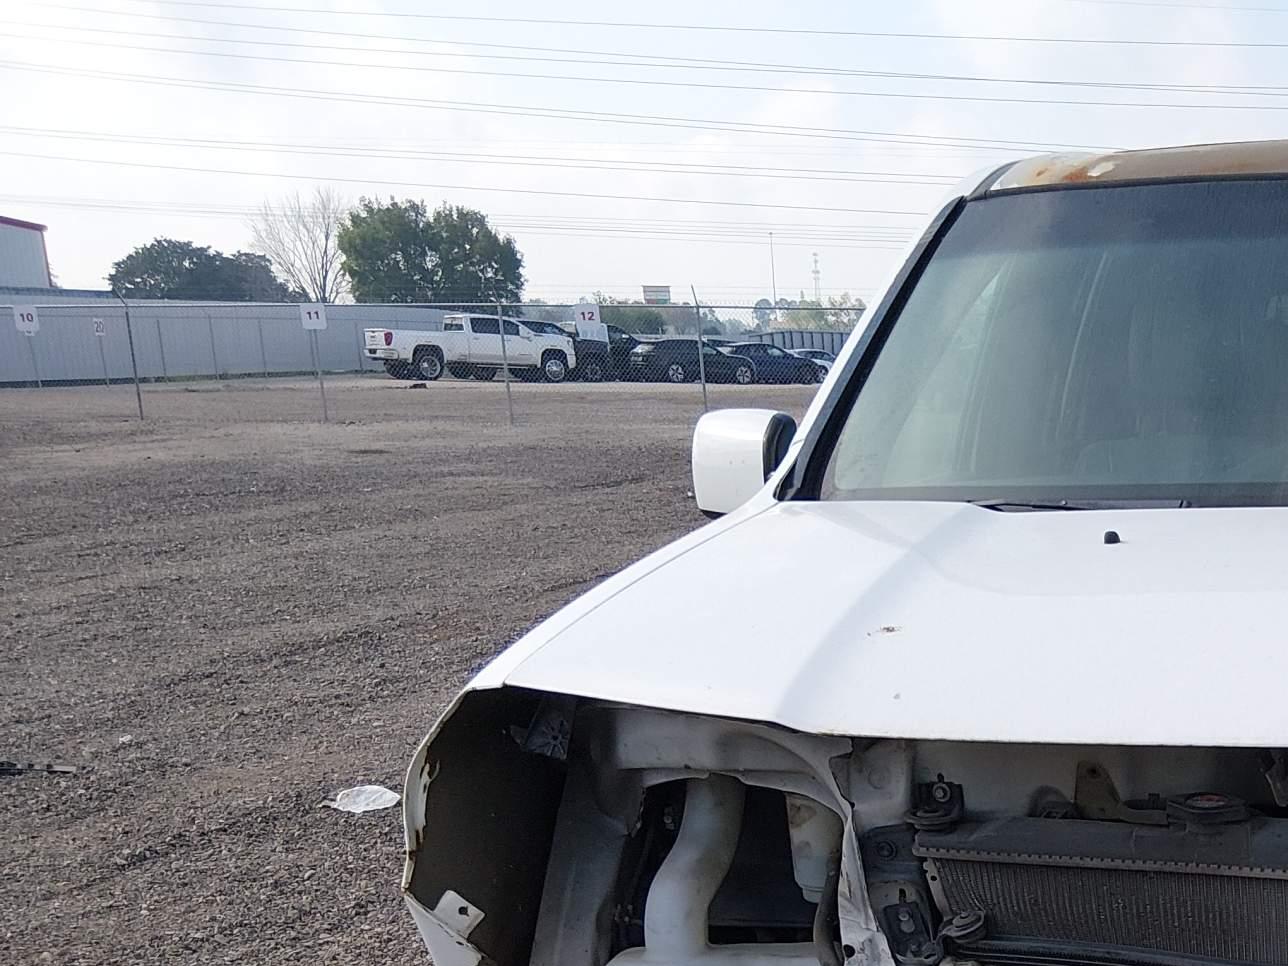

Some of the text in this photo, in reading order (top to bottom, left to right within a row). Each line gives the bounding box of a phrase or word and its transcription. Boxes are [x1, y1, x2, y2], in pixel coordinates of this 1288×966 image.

[19, 312, 34, 323] 10
[306, 310, 320, 321] 11
[580, 311, 596, 321] 12
